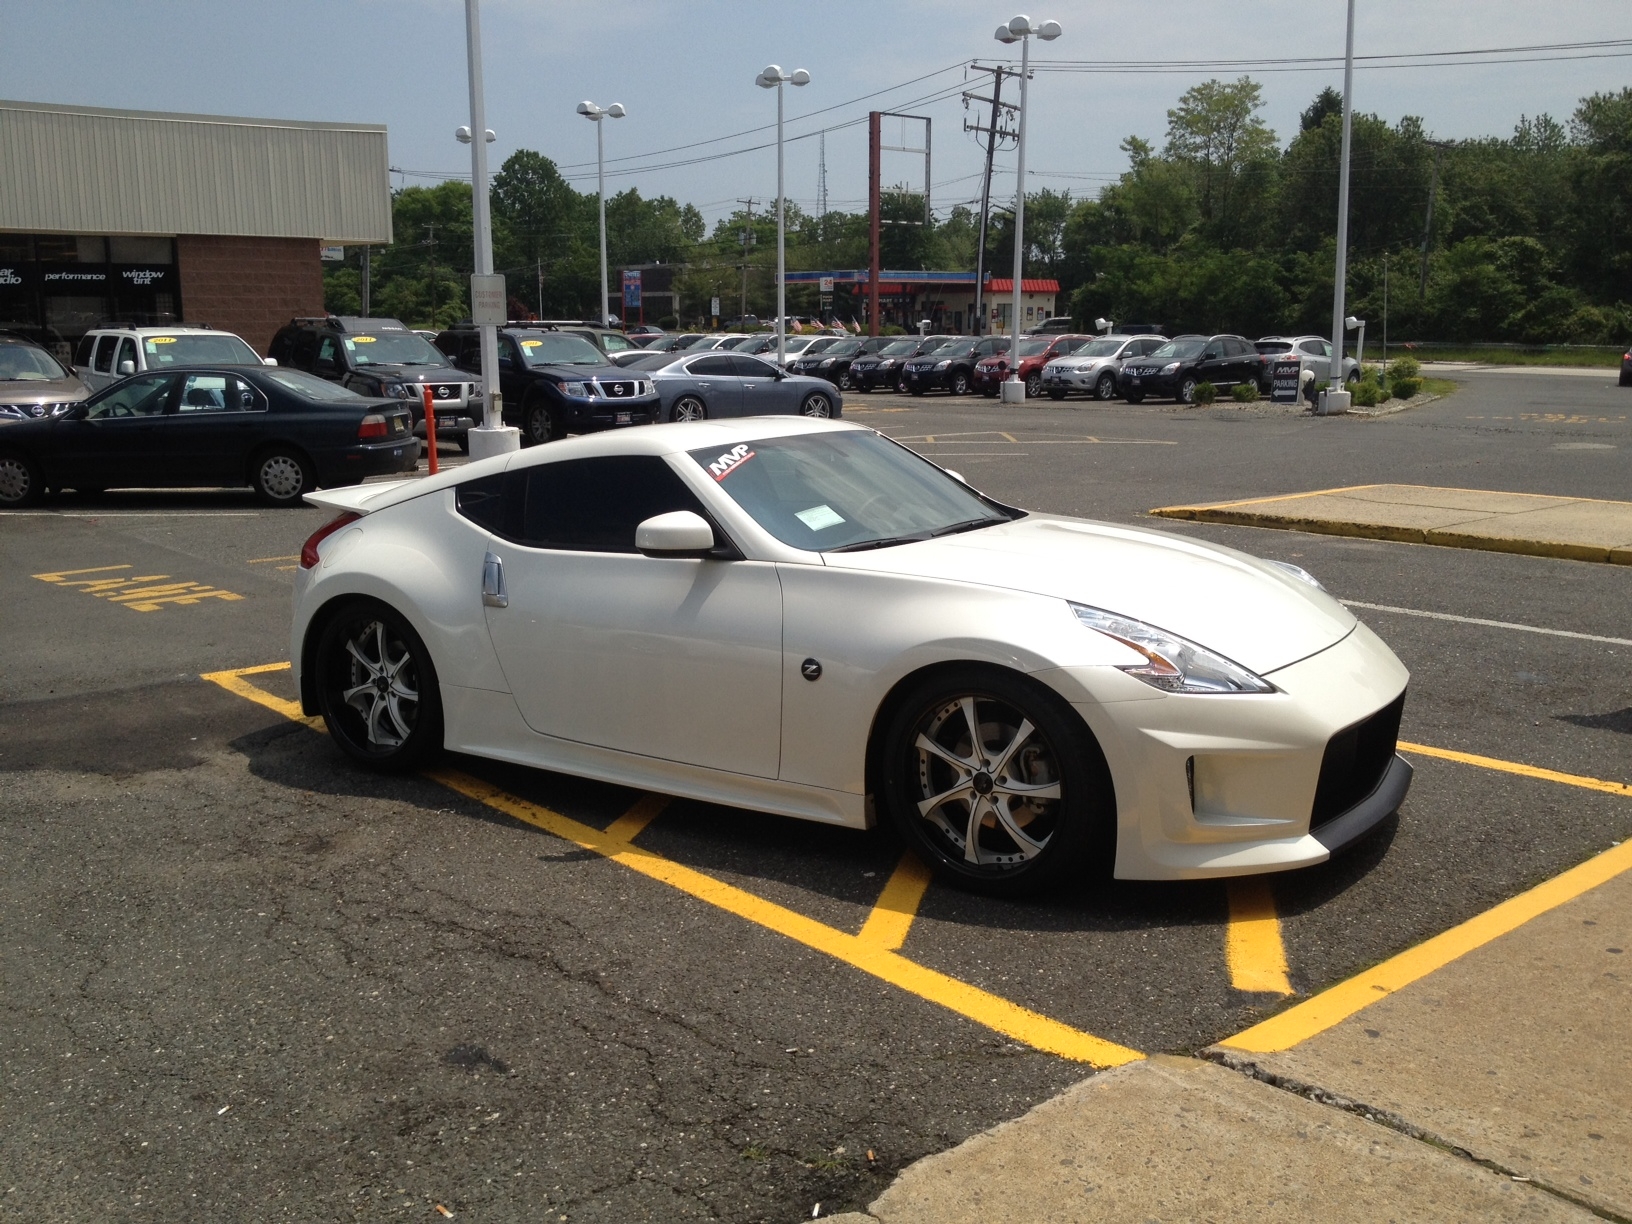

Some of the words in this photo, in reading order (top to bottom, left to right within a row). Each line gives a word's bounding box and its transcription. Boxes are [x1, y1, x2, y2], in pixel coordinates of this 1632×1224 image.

[44, 272, 106, 281] performance
[122, 269, 164, 278] window
[475, 290, 503, 299] CUSTOMER
[478, 301, 501, 309] PARKING
[1273, 379, 1297, 387] PARKING
[708, 444, 749, 477] MVP
